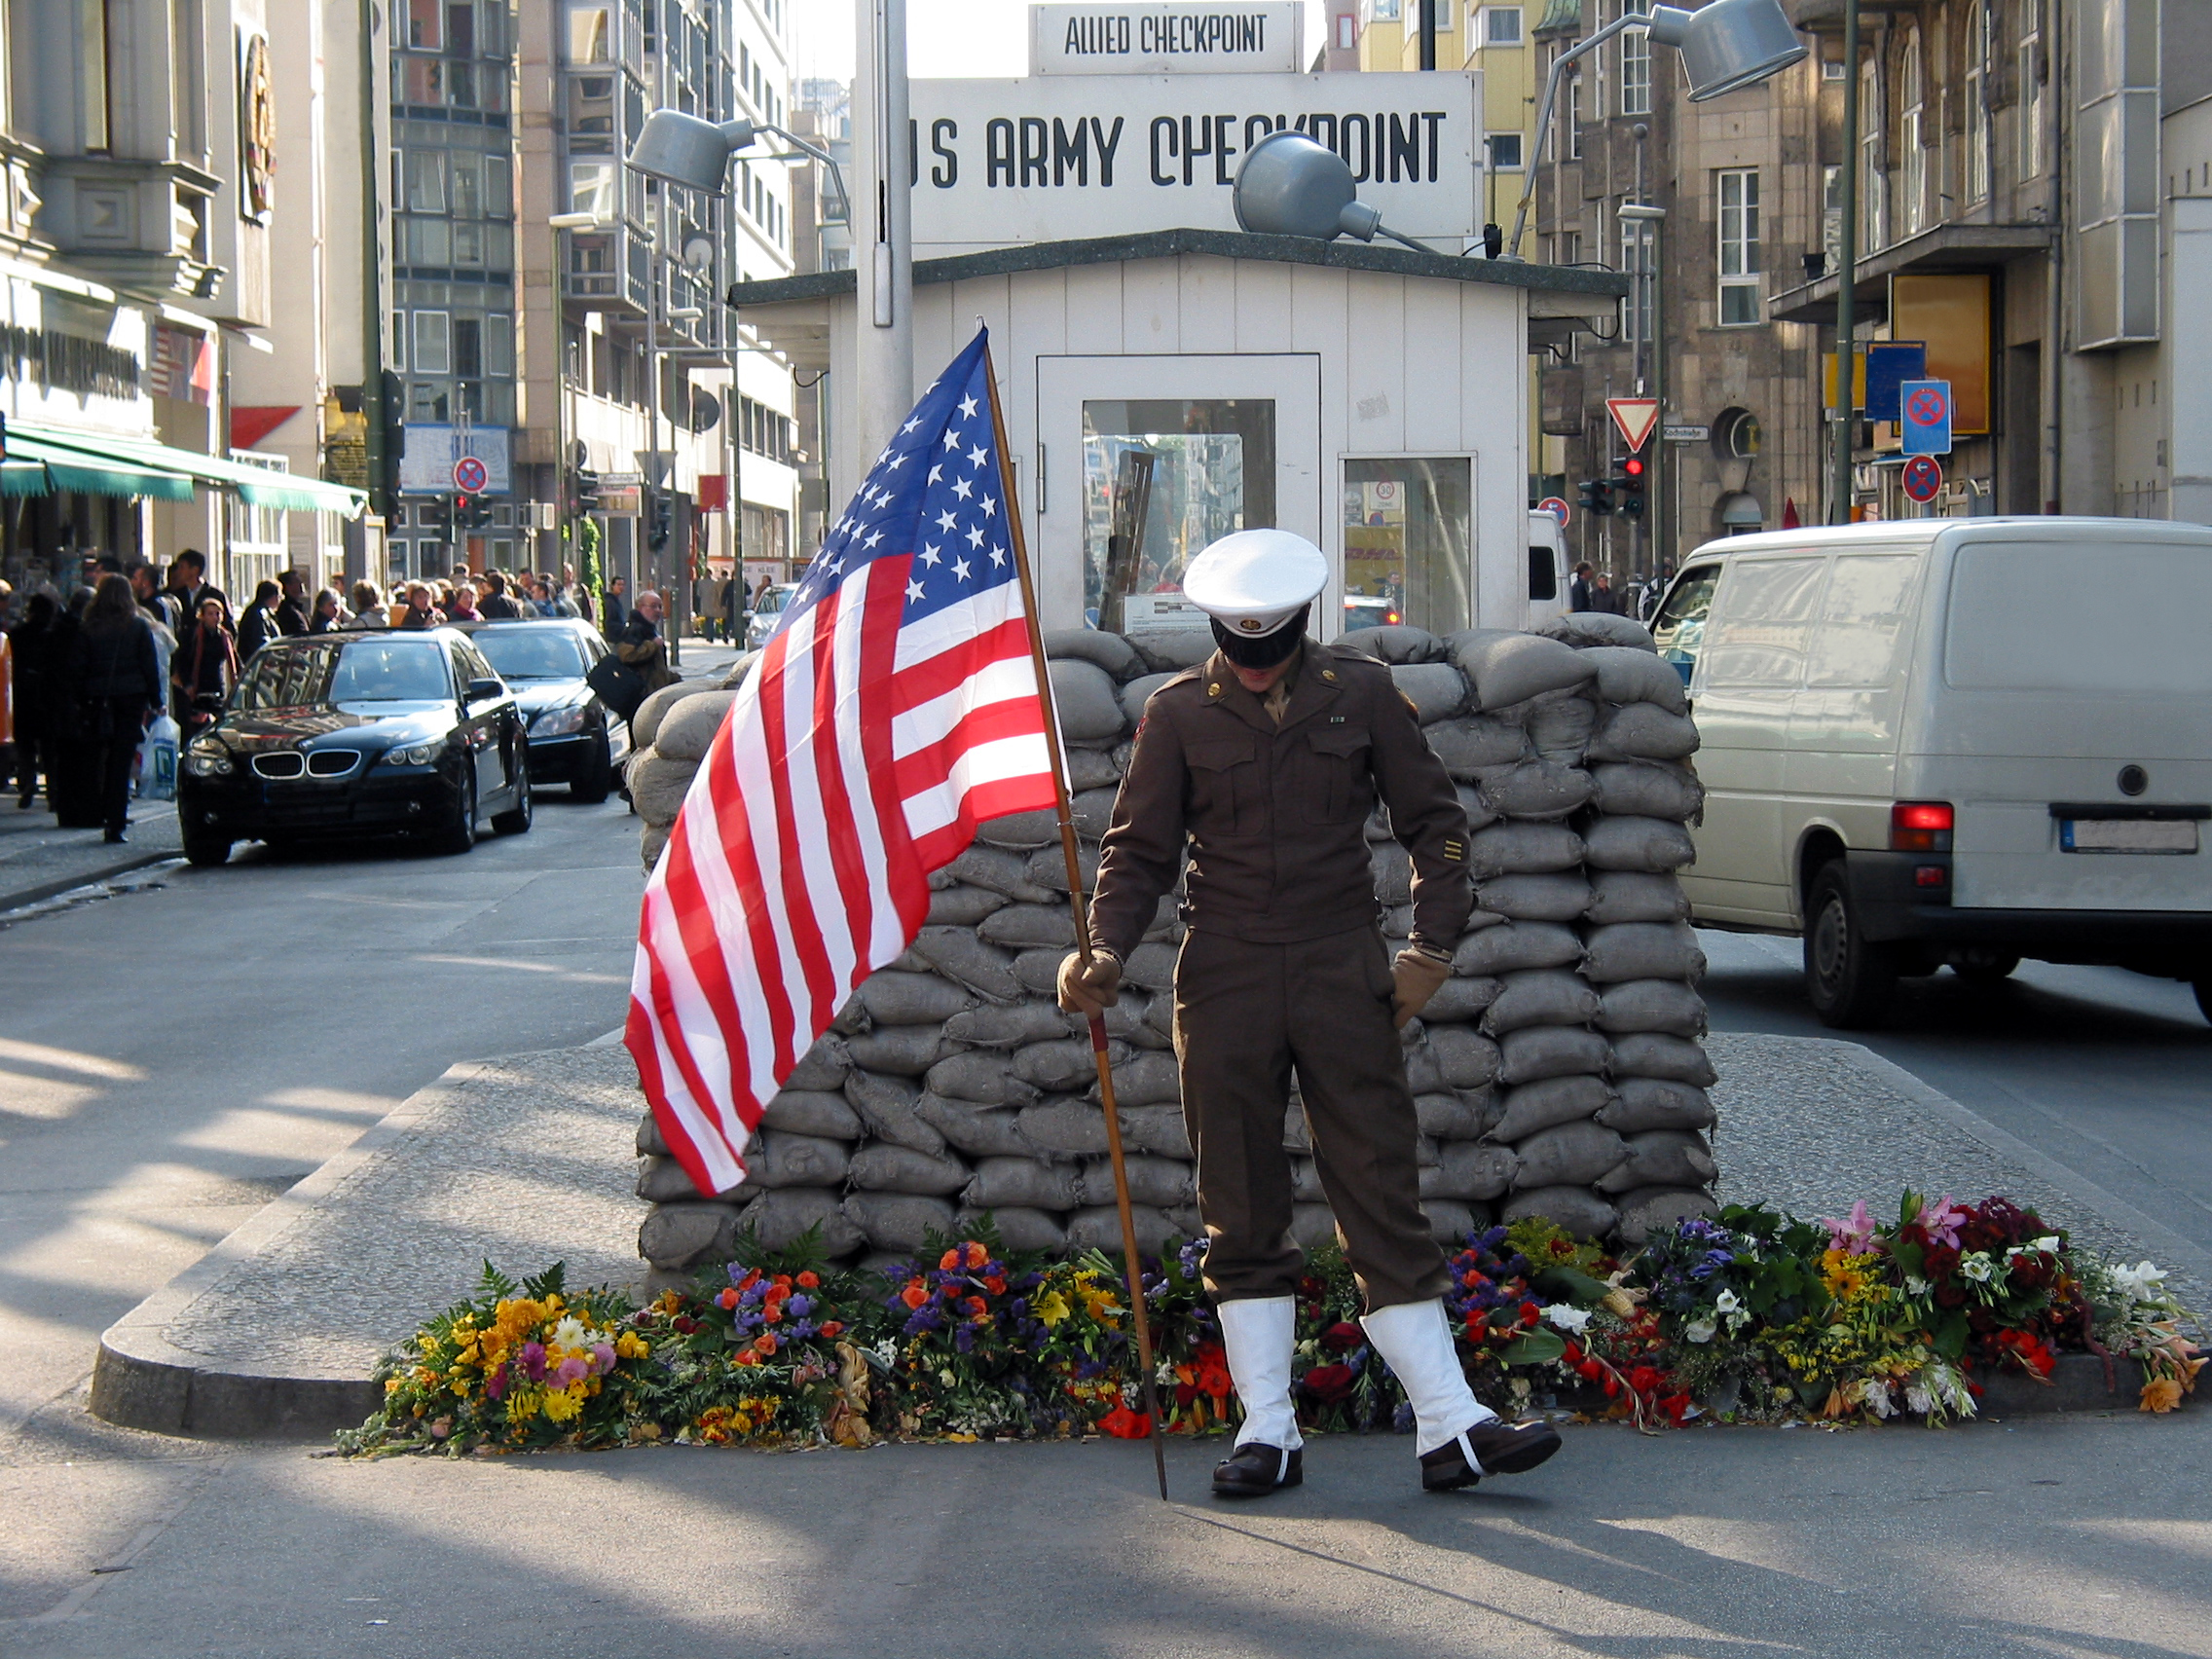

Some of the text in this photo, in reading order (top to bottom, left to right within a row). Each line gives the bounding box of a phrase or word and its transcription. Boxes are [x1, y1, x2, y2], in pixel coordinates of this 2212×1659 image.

[1065, 14, 1268, 55] ALLIED CHECKPOINT
[986, 116, 1125, 188] ARMY
[1381, 486, 1390, 495] 30
